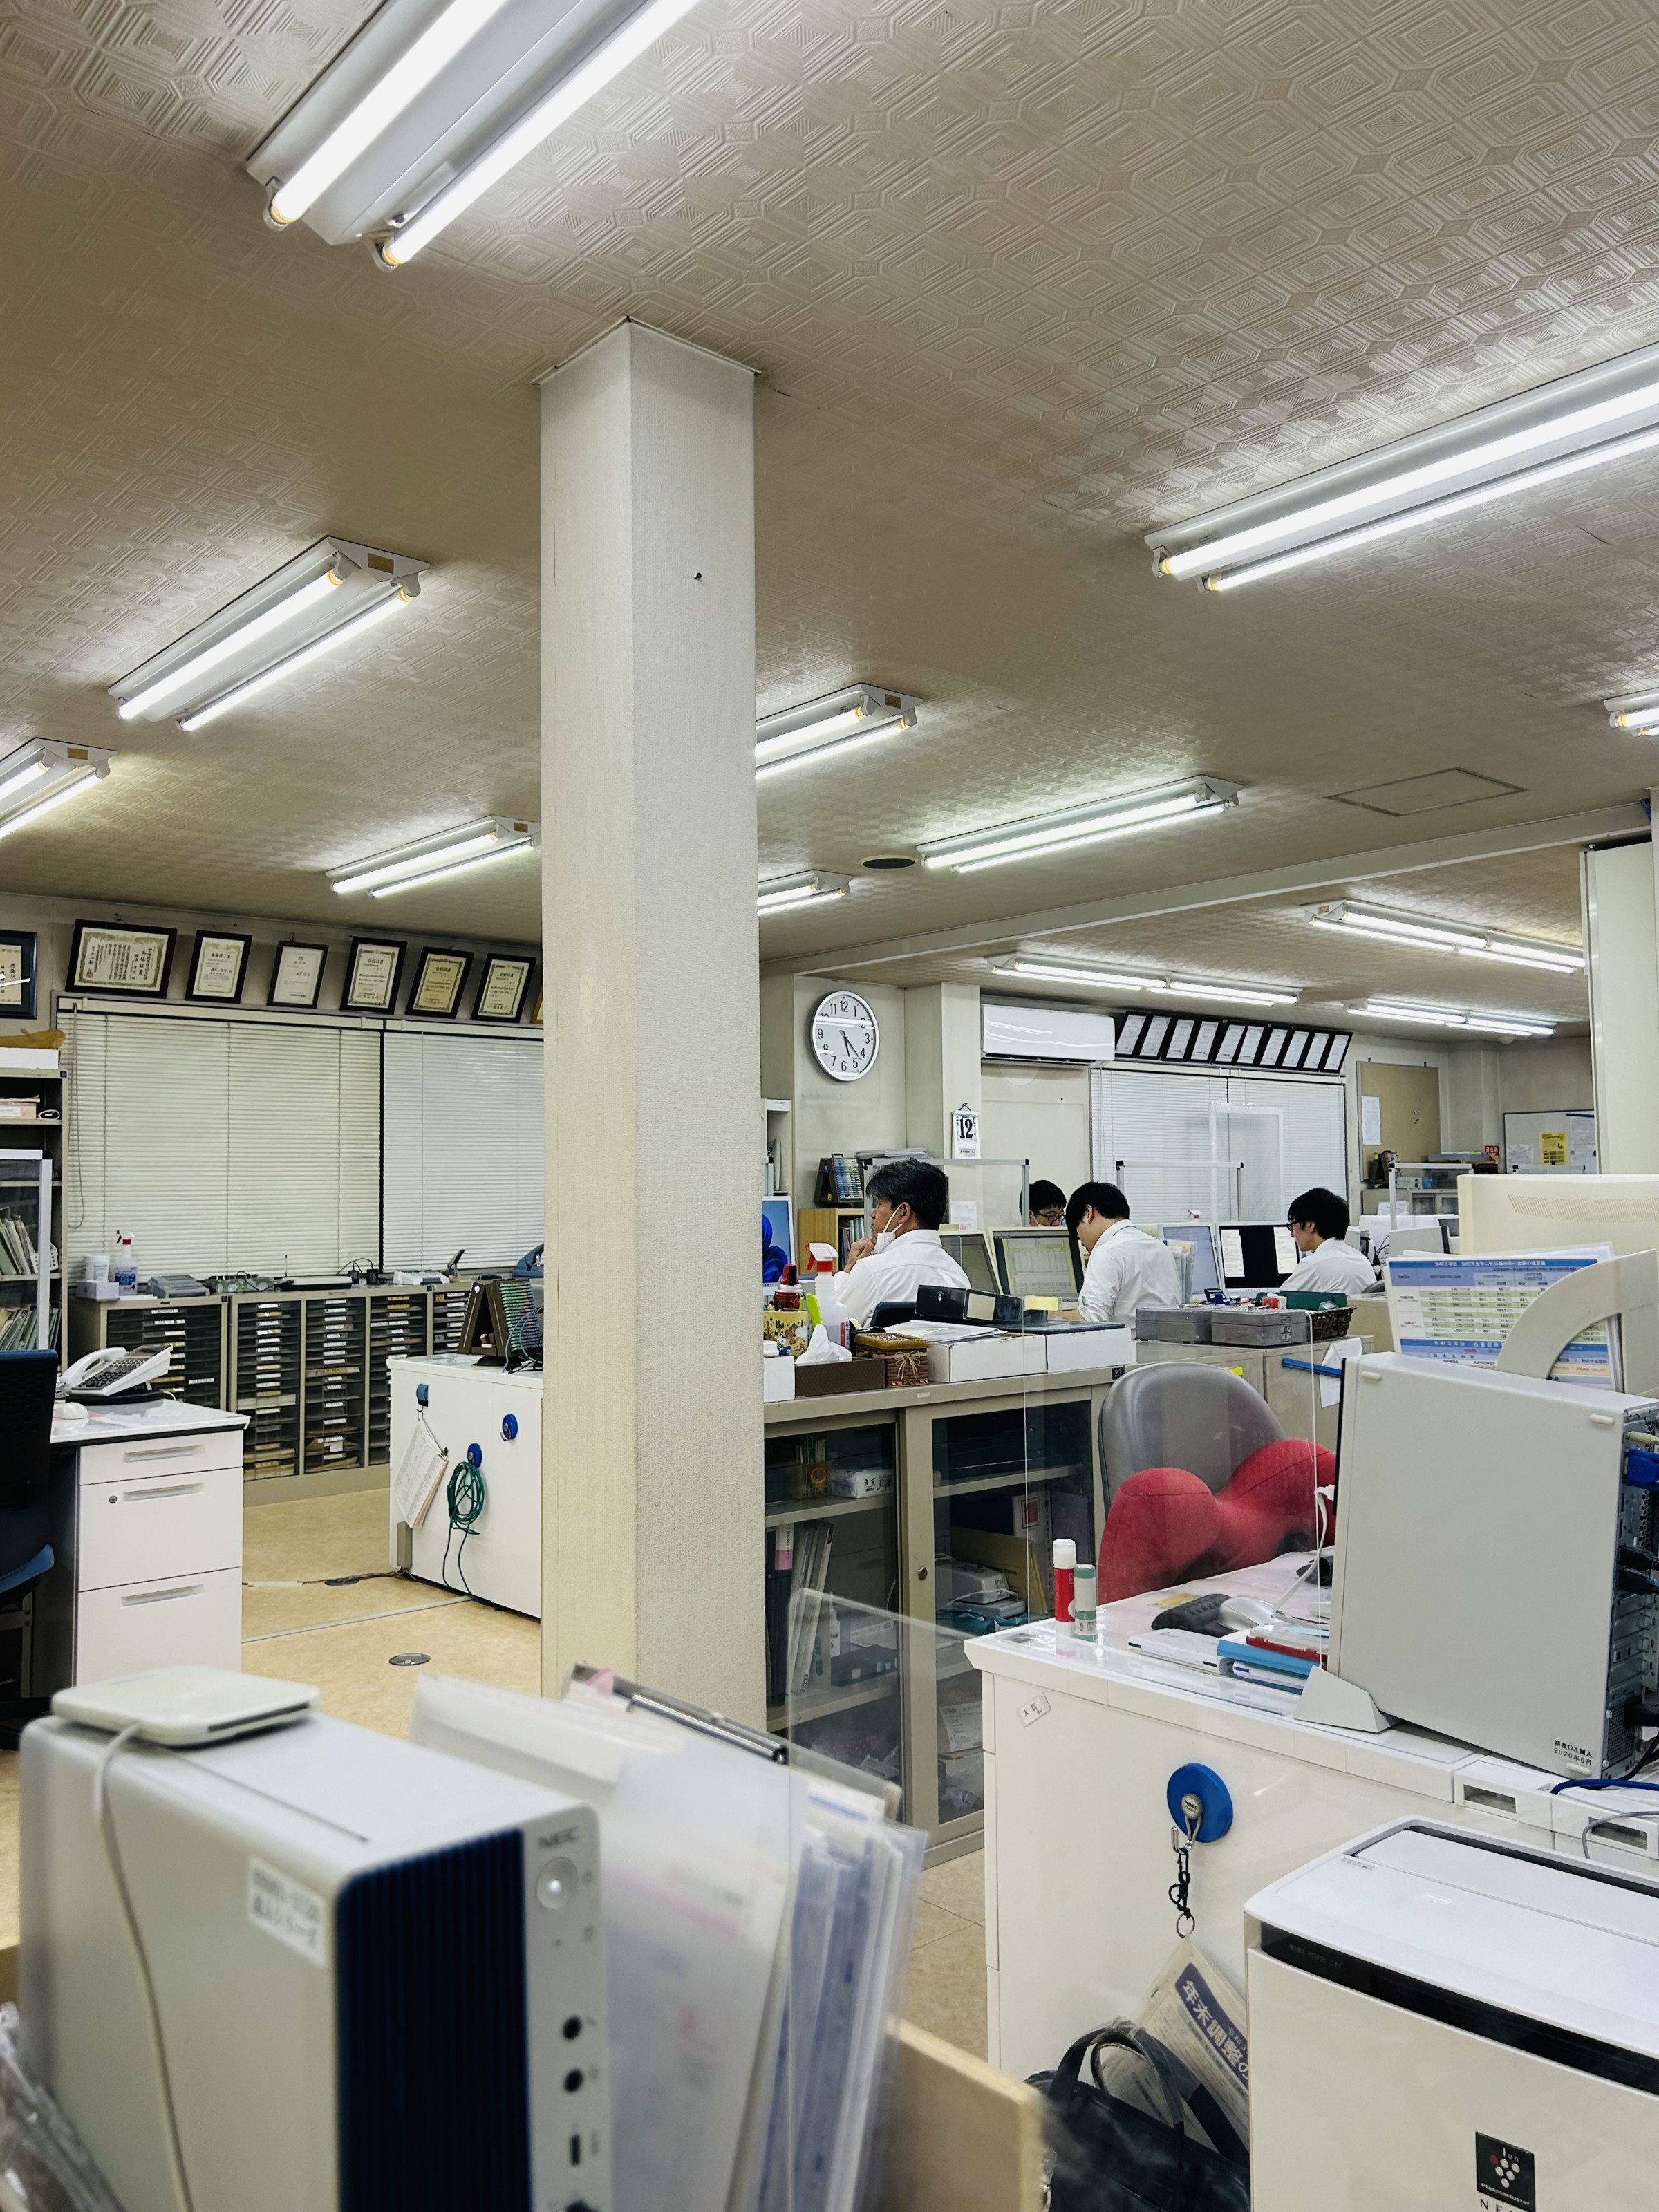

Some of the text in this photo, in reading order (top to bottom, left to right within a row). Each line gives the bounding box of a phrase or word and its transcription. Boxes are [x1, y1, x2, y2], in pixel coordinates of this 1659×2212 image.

[830, 1003, 837, 1015] 11
[840, 1000, 848, 1013] 12
[854, 1006, 856, 1018] 1
[817, 1028, 823, 1040] 9
[864, 1033, 870, 1044] 3
[861, 1047, 865, 1058] 4
[831, 1056, 836, 1066] 7
[841, 1060, 847, 1072] 6
[852, 1057, 858, 1069] 5
[959, 1118, 973, 1138] 12
[1554, 1739, 1593, 1759] 奈良OA購入
[1553, 1747, 1592, 1766] 2020年6月
[538, 1826, 580, 1849] NEC
[1182, 1980, 1248, 2079] 年末調整の
[1503, 2146, 1519, 2162] Ion
[1481, 2182, 1530, 2206] Plasmacluster
